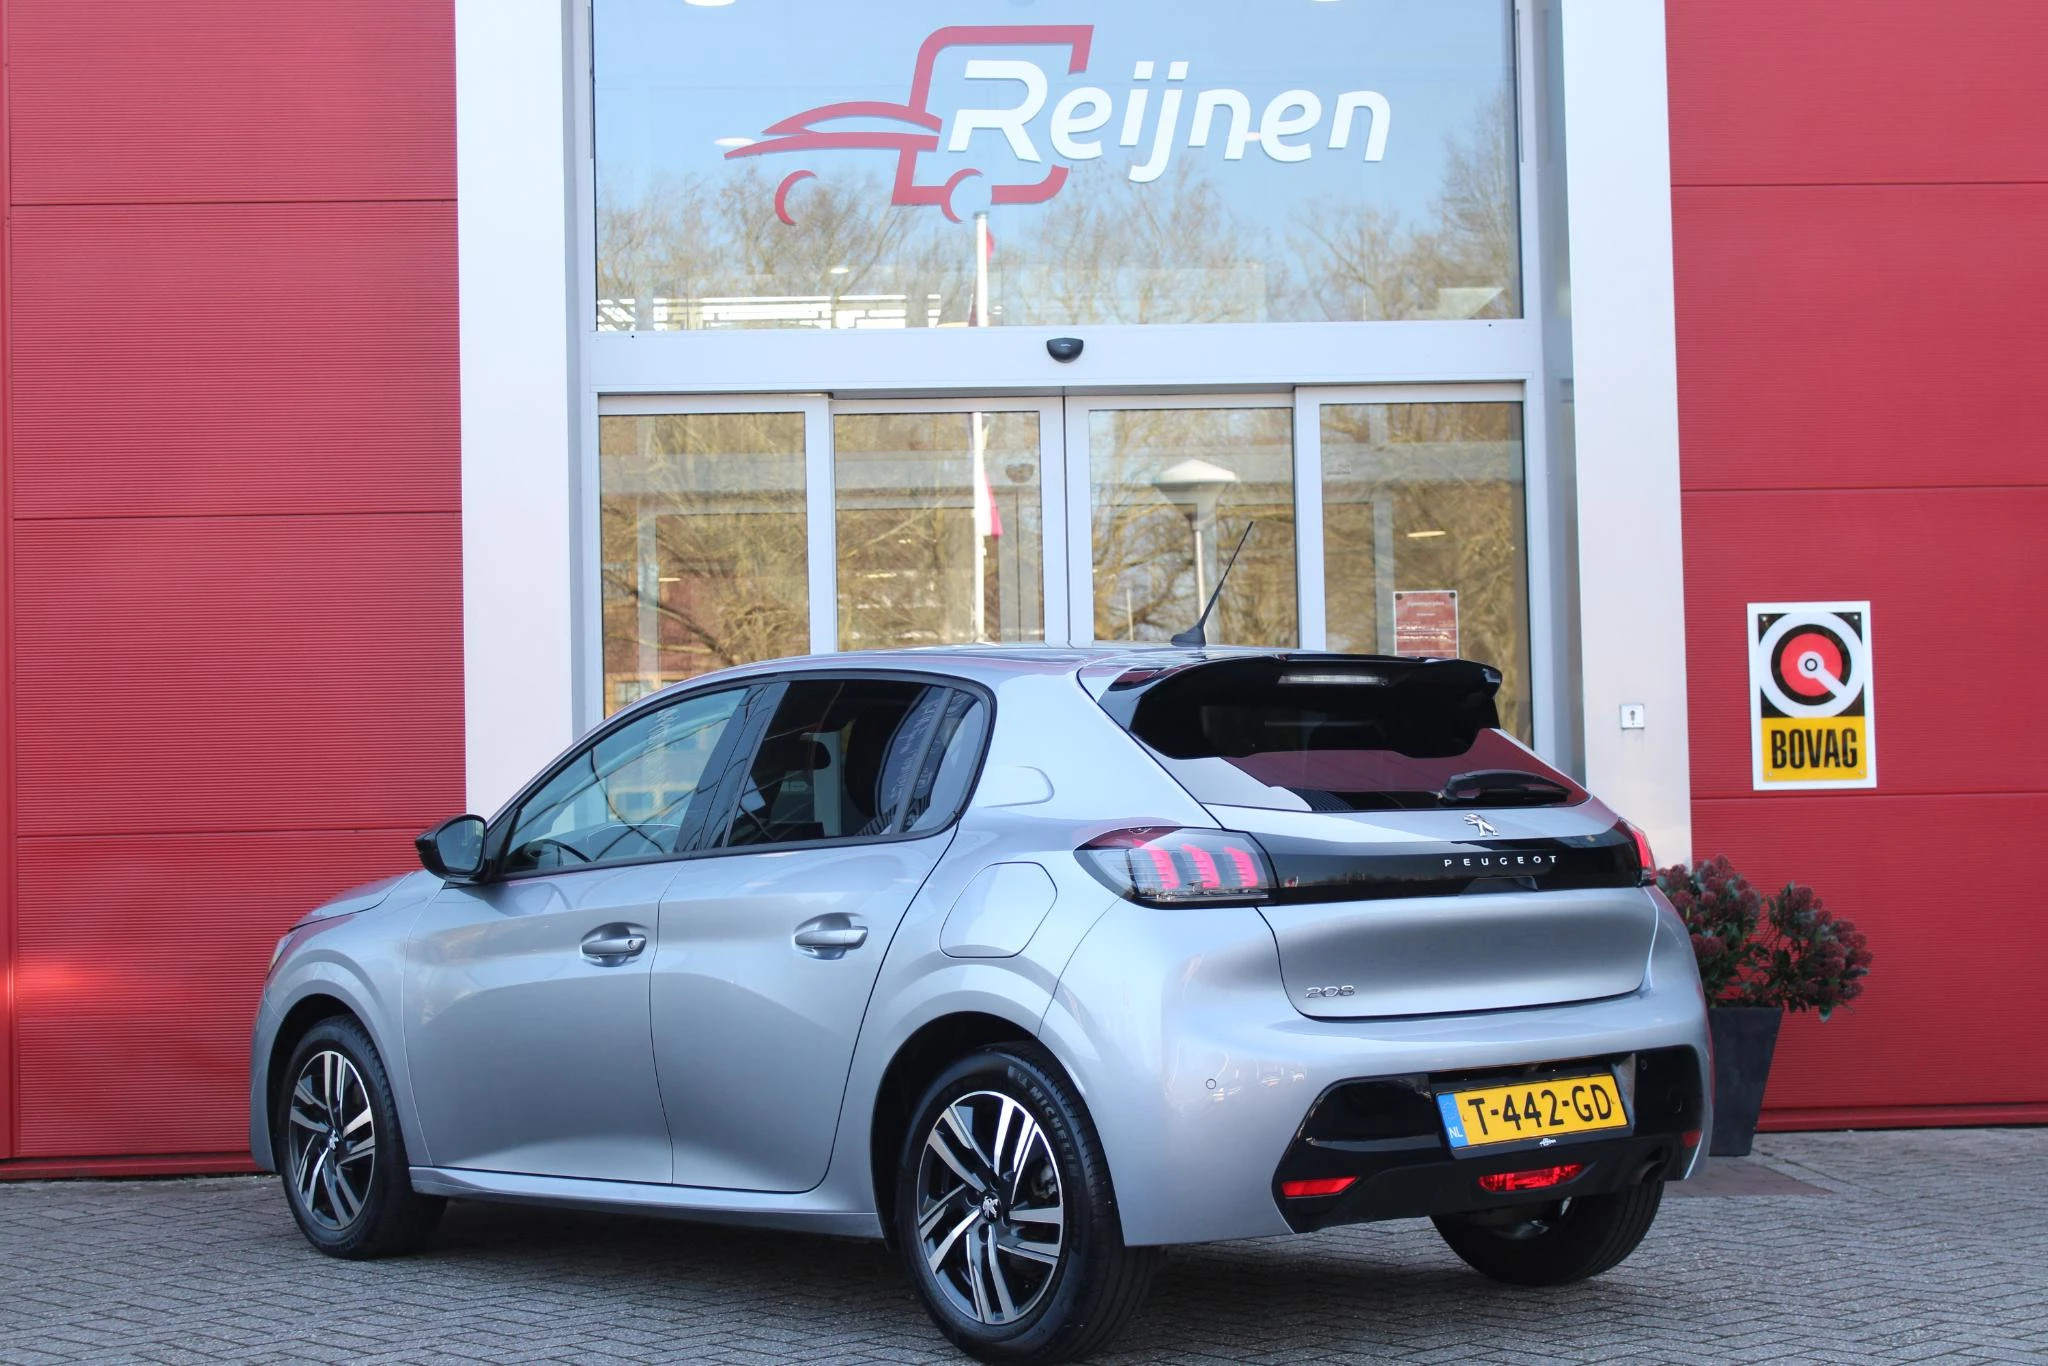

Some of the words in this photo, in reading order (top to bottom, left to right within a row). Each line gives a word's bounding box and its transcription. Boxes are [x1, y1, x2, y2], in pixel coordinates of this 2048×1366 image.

[947, 59, 1392, 183] Reijnen
[1771, 728, 1858, 769] BOVAG
[1443, 855, 1557, 867] PEUGEOT
[1304, 985, 1355, 998] 208
[1467, 1084, 1612, 1135] T-442-GD
[1448, 1125, 1464, 1139] NL
